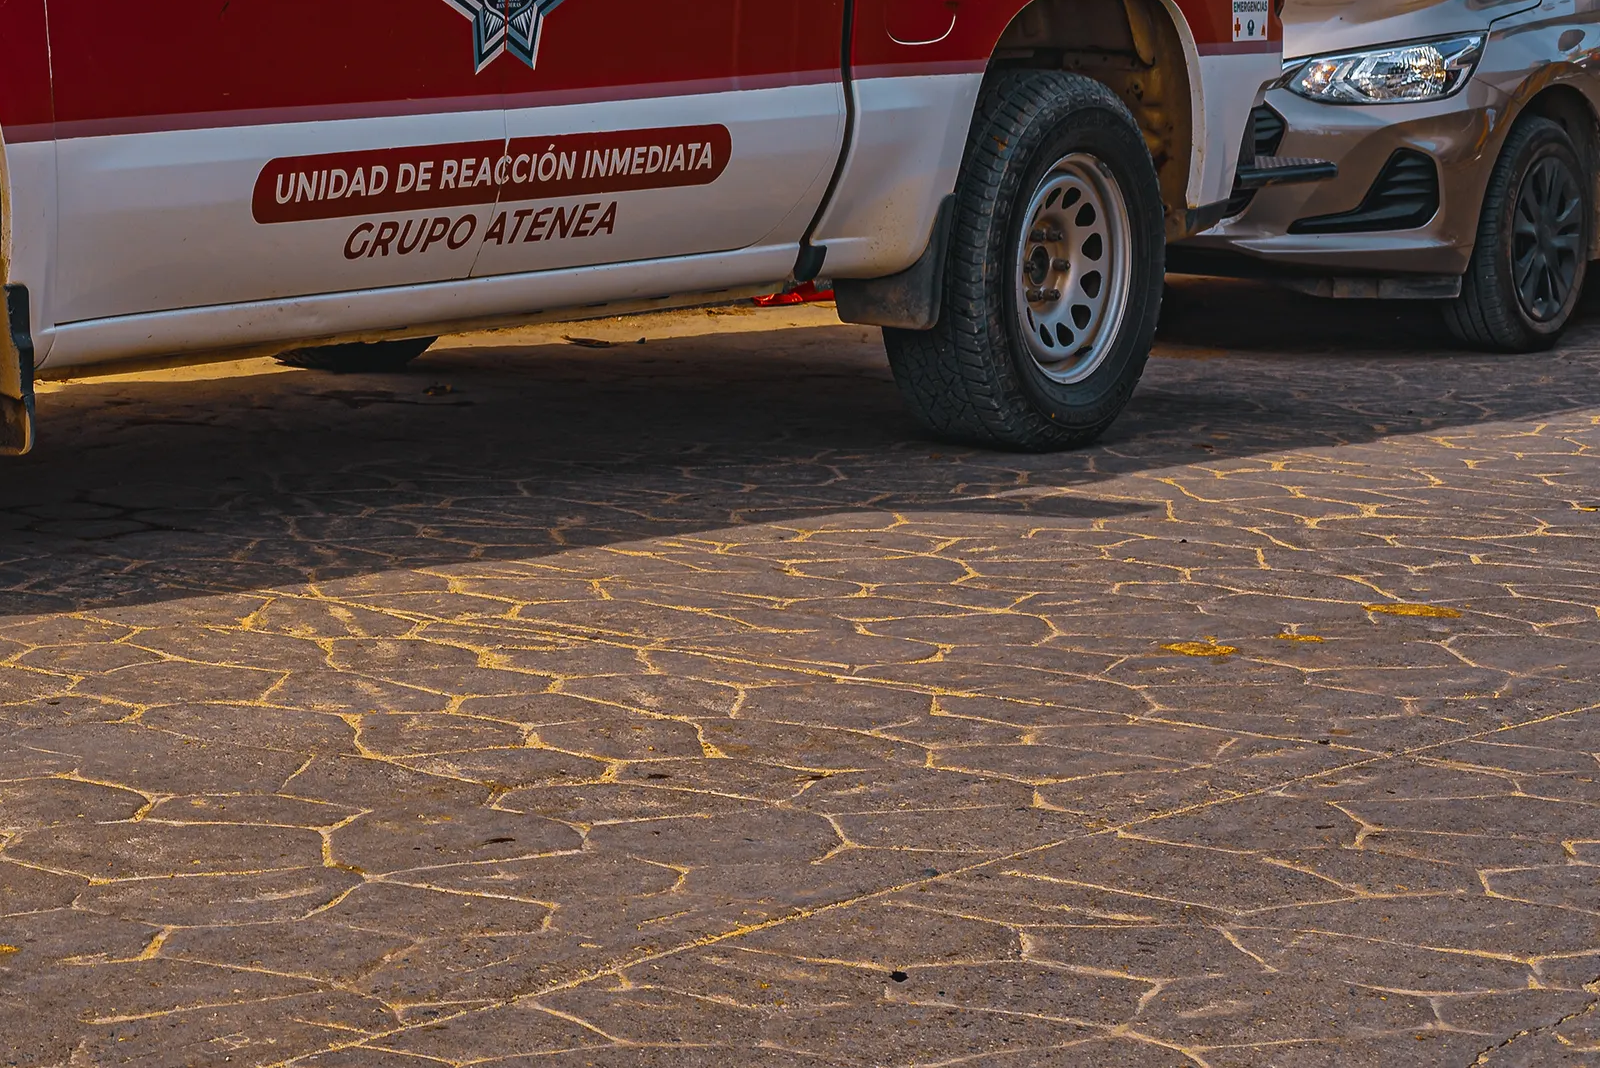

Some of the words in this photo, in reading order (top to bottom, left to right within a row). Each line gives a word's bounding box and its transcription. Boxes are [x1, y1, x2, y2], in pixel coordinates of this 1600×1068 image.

[1233, 0, 1268, 13] EMERGENCIAS
[275, 164, 389, 205] UNIDAD
[396, 161, 433, 194] DE
[439, 144, 574, 190] REACCIÓN
[581, 142, 714, 180] INMEDIATA
[343, 214, 478, 261] GRUPO
